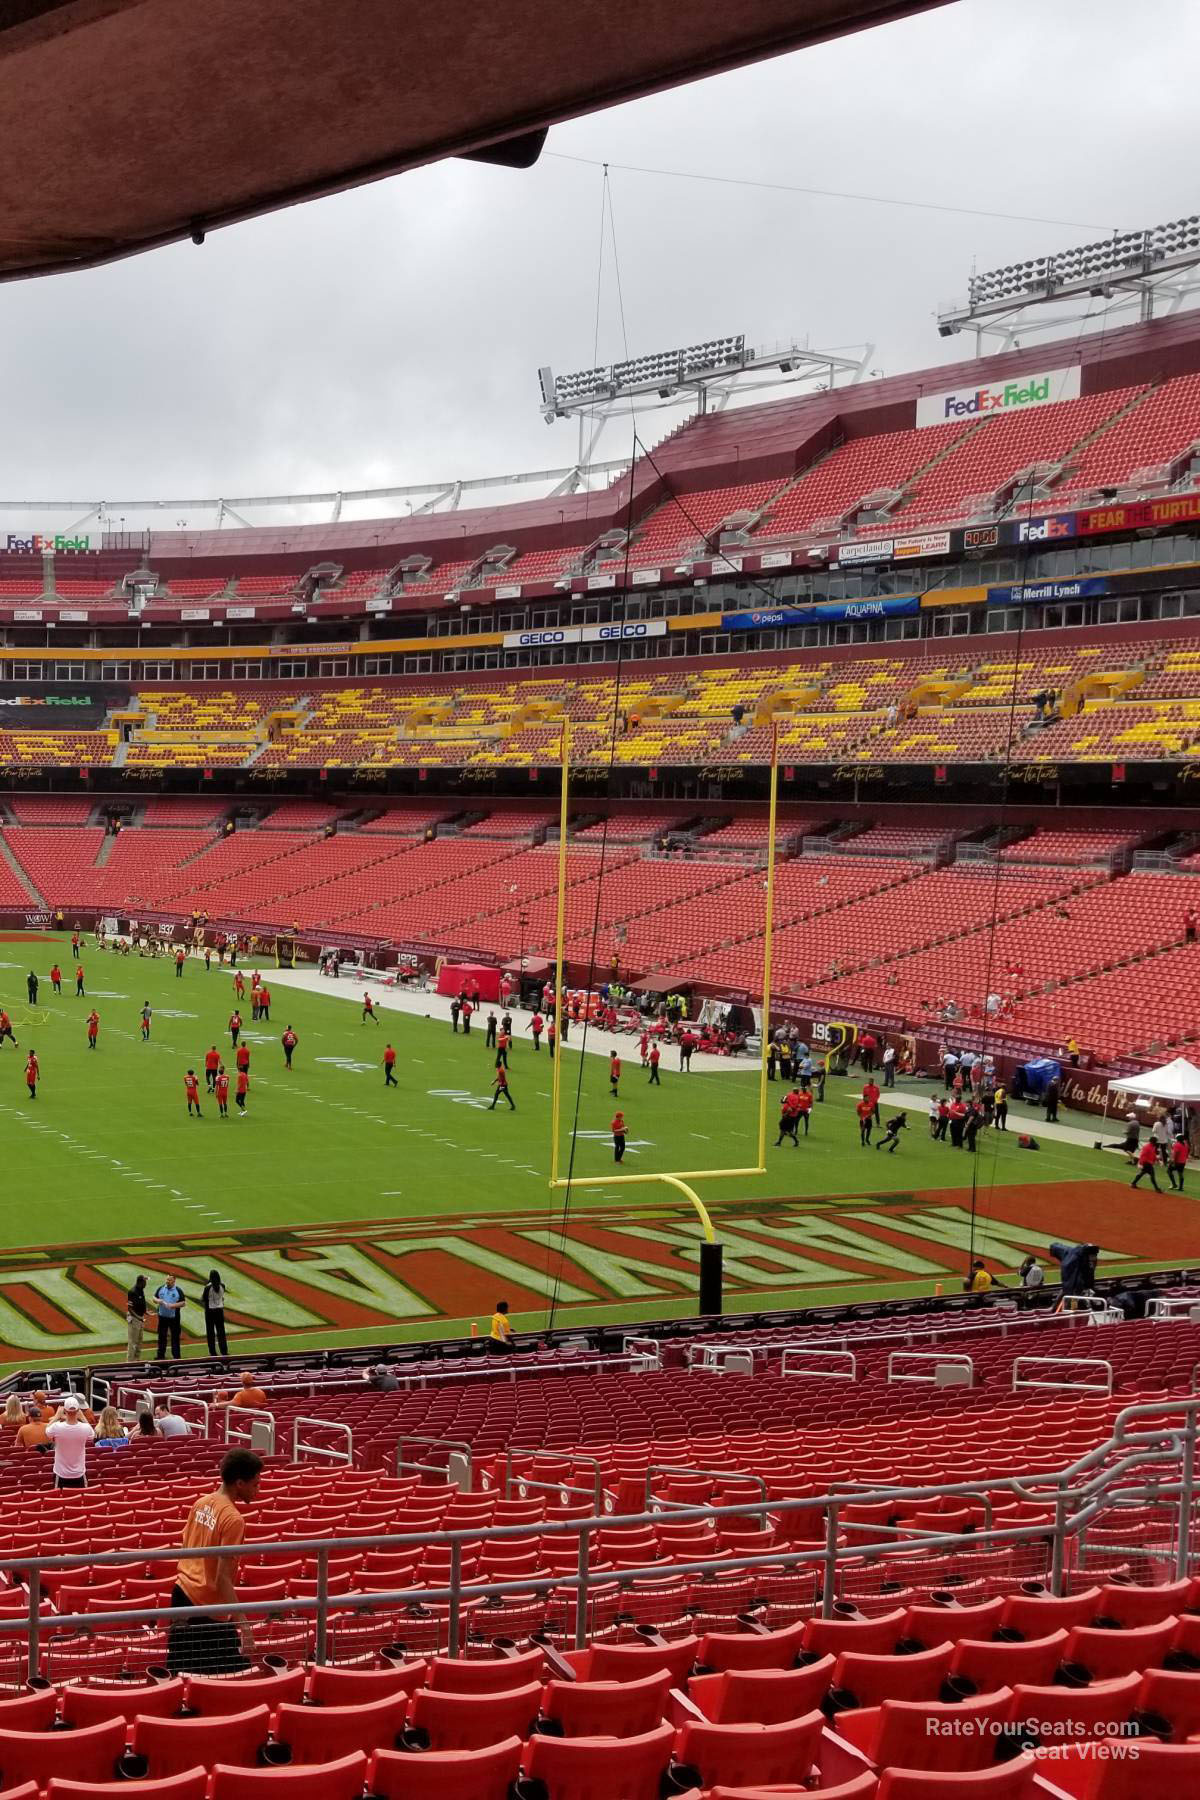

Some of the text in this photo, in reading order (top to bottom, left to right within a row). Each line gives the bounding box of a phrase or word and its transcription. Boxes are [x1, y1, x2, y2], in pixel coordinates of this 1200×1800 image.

[945, 378, 1049, 418] FedExField
[1019, 518, 1070, 542] FedEx
[7, 534, 89, 550] FedExField
[908, 537, 926, 545] Future
[921, 542, 947, 550] LEARN
[841, 542, 883, 557] Carpetland
[1023, 586, 1052, 599] Merrill
[1054, 583, 1080, 597] Lynch
[845, 601, 885, 618] AQUAFINA
[761, 612, 783, 625] pepsi
[519, 631, 565, 645] GEICO
[600, 624, 647, 639] GEICO
[1072, 1083, 1086, 1101] to
[1087, 1086, 1109, 1106] the
